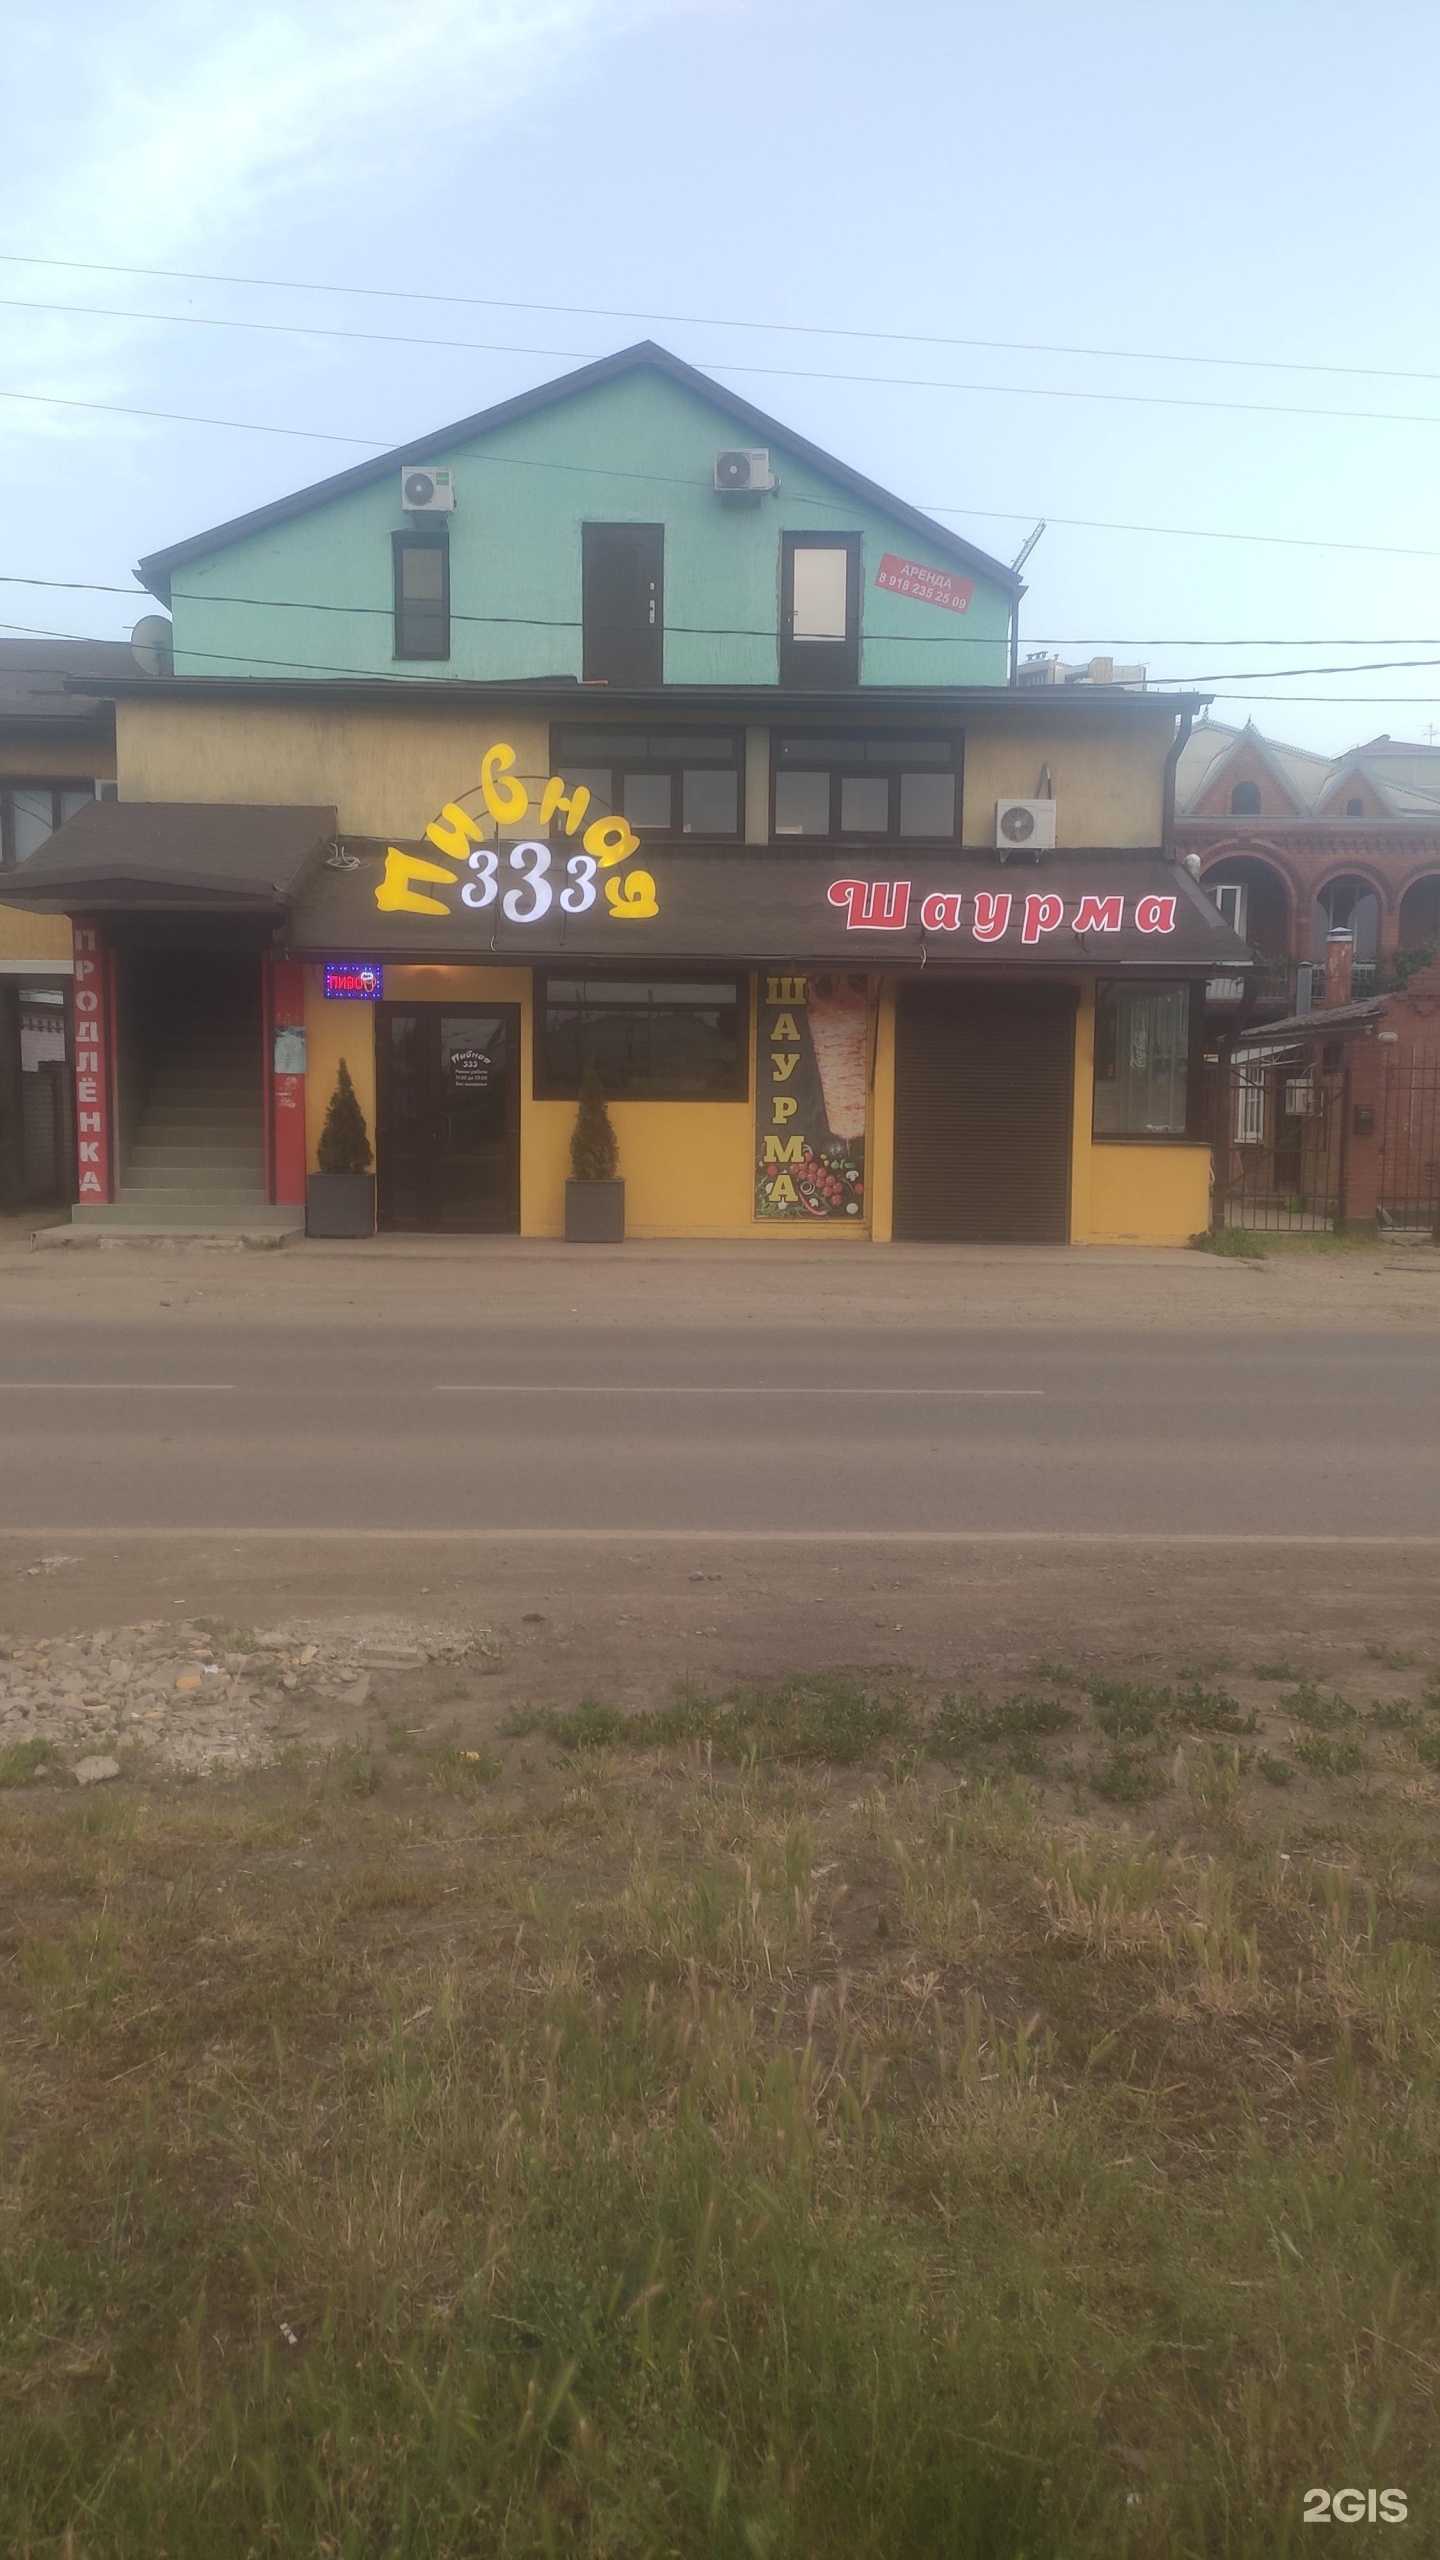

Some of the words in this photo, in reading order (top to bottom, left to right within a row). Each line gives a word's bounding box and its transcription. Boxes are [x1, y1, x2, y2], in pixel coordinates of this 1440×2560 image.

[879, 571, 887, 583] 8
[888, 575, 910, 591] 918
[911, 583, 934, 599] 235
[900, 564, 952, 590] АРЕНДА
[374, 742, 660, 919] Пивная
[461, 841, 597, 923] 333
[827, 879, 1177, 944] Шаурма
[74, 928, 102, 1193] ПРОДЛЁНКА
[764, 977, 808, 1202] ШАУРМА
